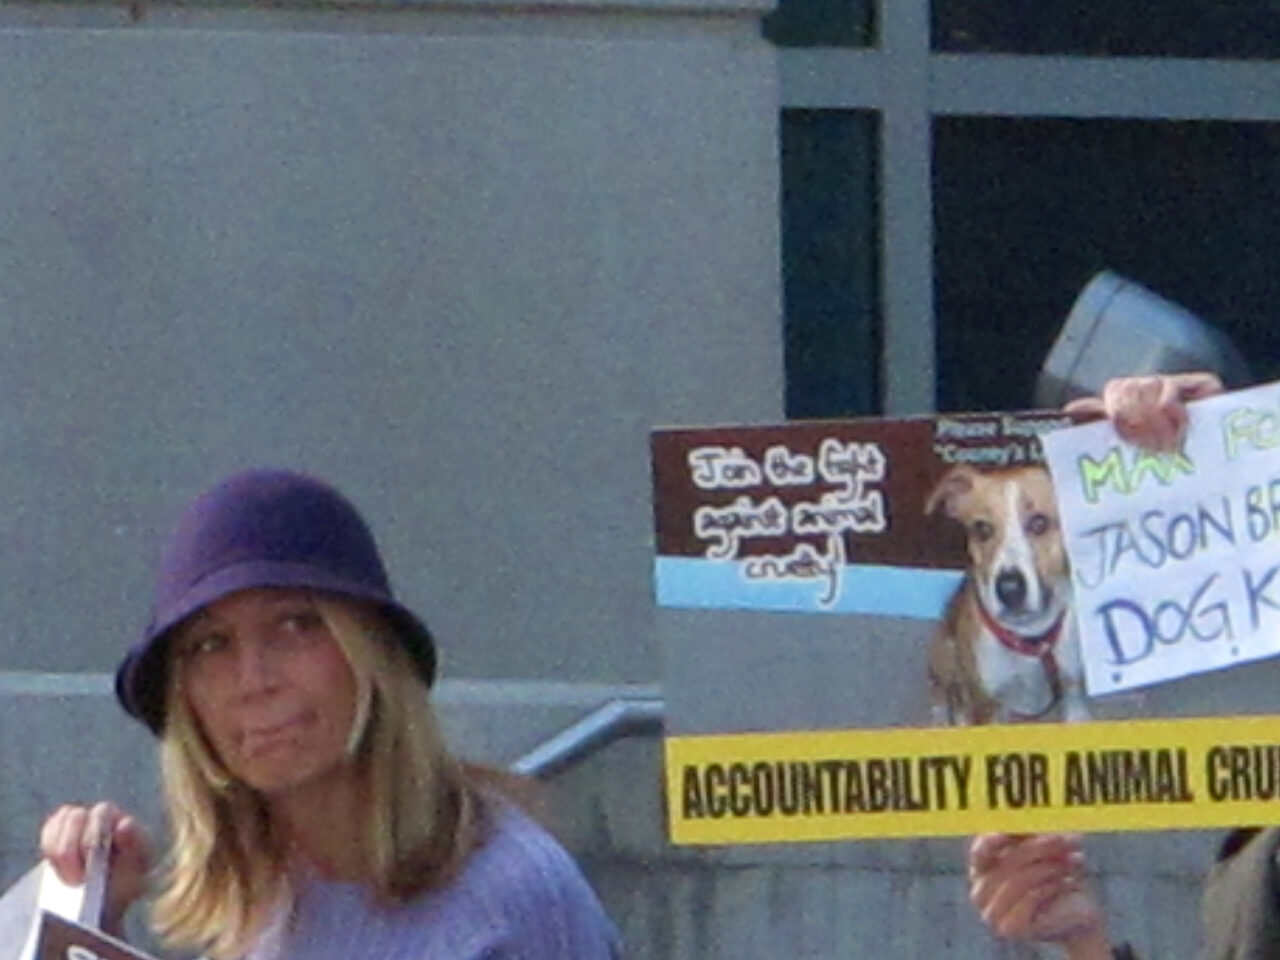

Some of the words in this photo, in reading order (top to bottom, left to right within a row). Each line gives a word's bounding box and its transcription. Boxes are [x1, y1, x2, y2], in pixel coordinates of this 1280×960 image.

[766, 448, 813, 483] the
[820, 440, 884, 499] fight
[794, 493, 884, 533] animal
[1078, 497, 1236, 590] JASON
[1095, 571, 1236, 667] DOG
[681, 754, 974, 820] ACCOUNTABILITY
[985, 752, 1049, 809] FOR
[1062, 748, 1193, 807] ANIMAL
